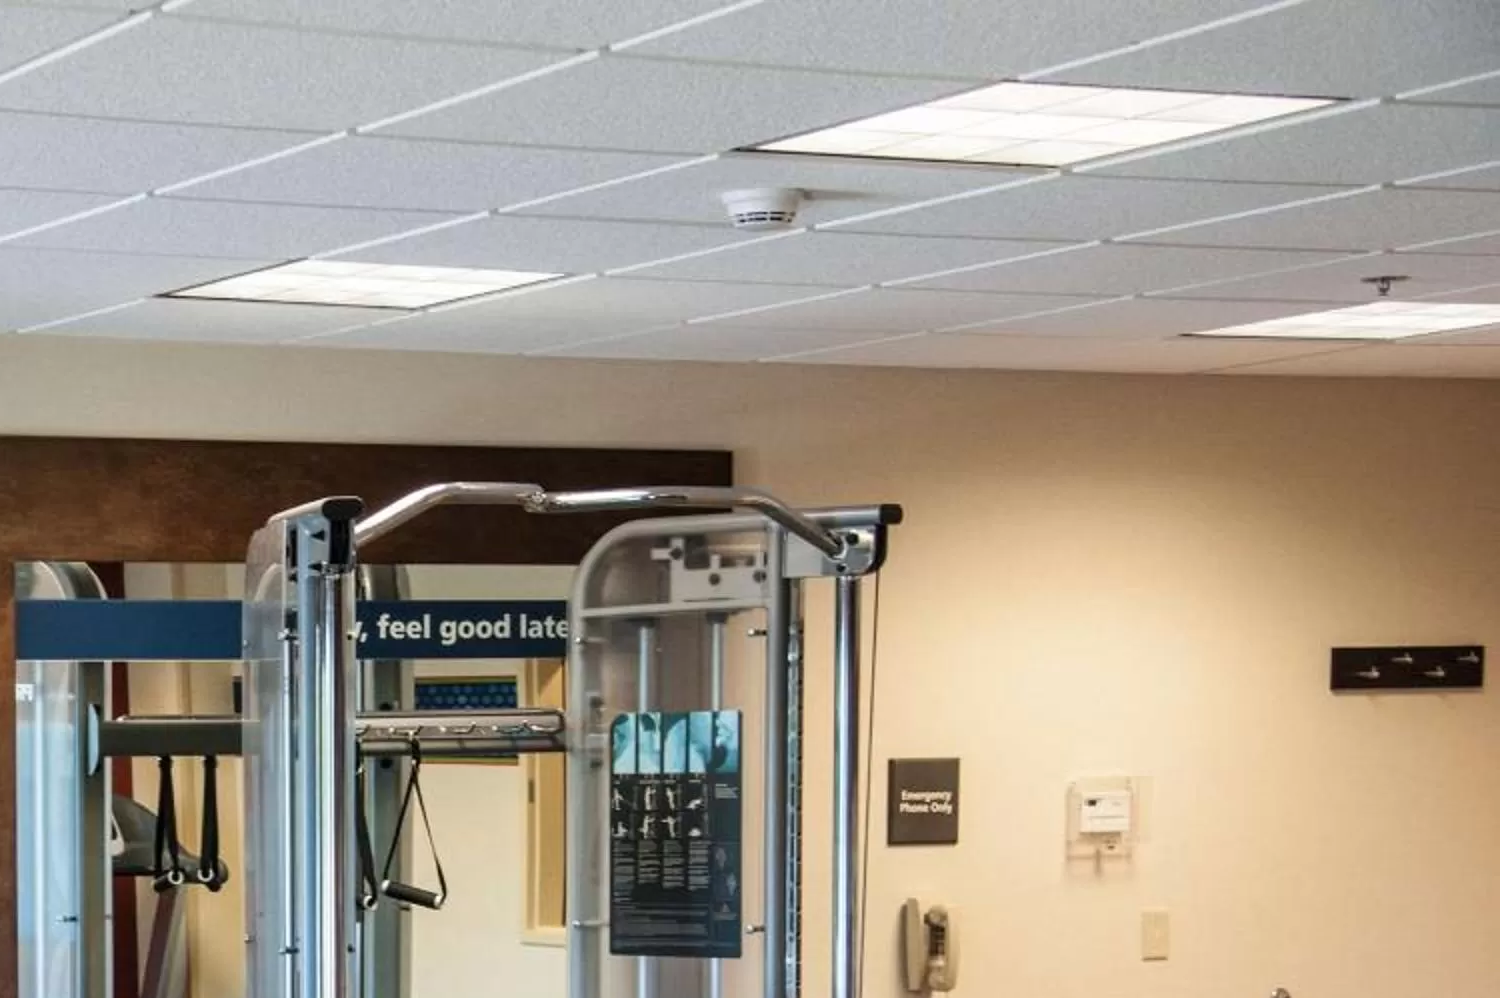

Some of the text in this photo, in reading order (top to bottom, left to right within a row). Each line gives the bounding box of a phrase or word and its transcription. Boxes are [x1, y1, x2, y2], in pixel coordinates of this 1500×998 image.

[377, 613, 432, 639] feel
[439, 613, 511, 645] good
[519, 614, 570, 639] late
